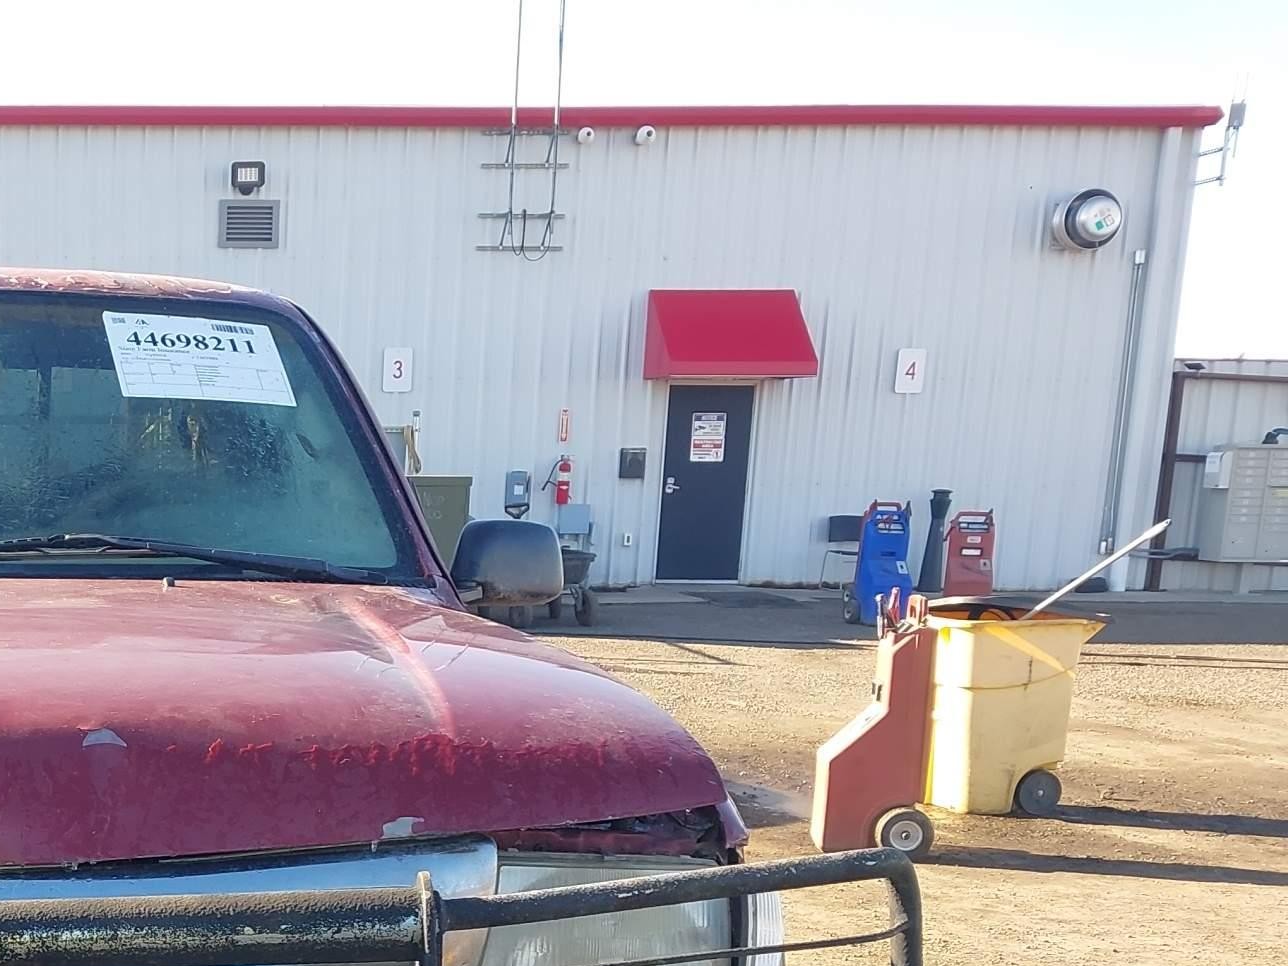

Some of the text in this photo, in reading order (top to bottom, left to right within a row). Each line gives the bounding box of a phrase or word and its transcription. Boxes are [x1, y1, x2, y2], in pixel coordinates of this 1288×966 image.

[126, 330, 257, 355] 44698211
[392, 360, 403, 379] 3
[904, 361, 917, 380] 4
